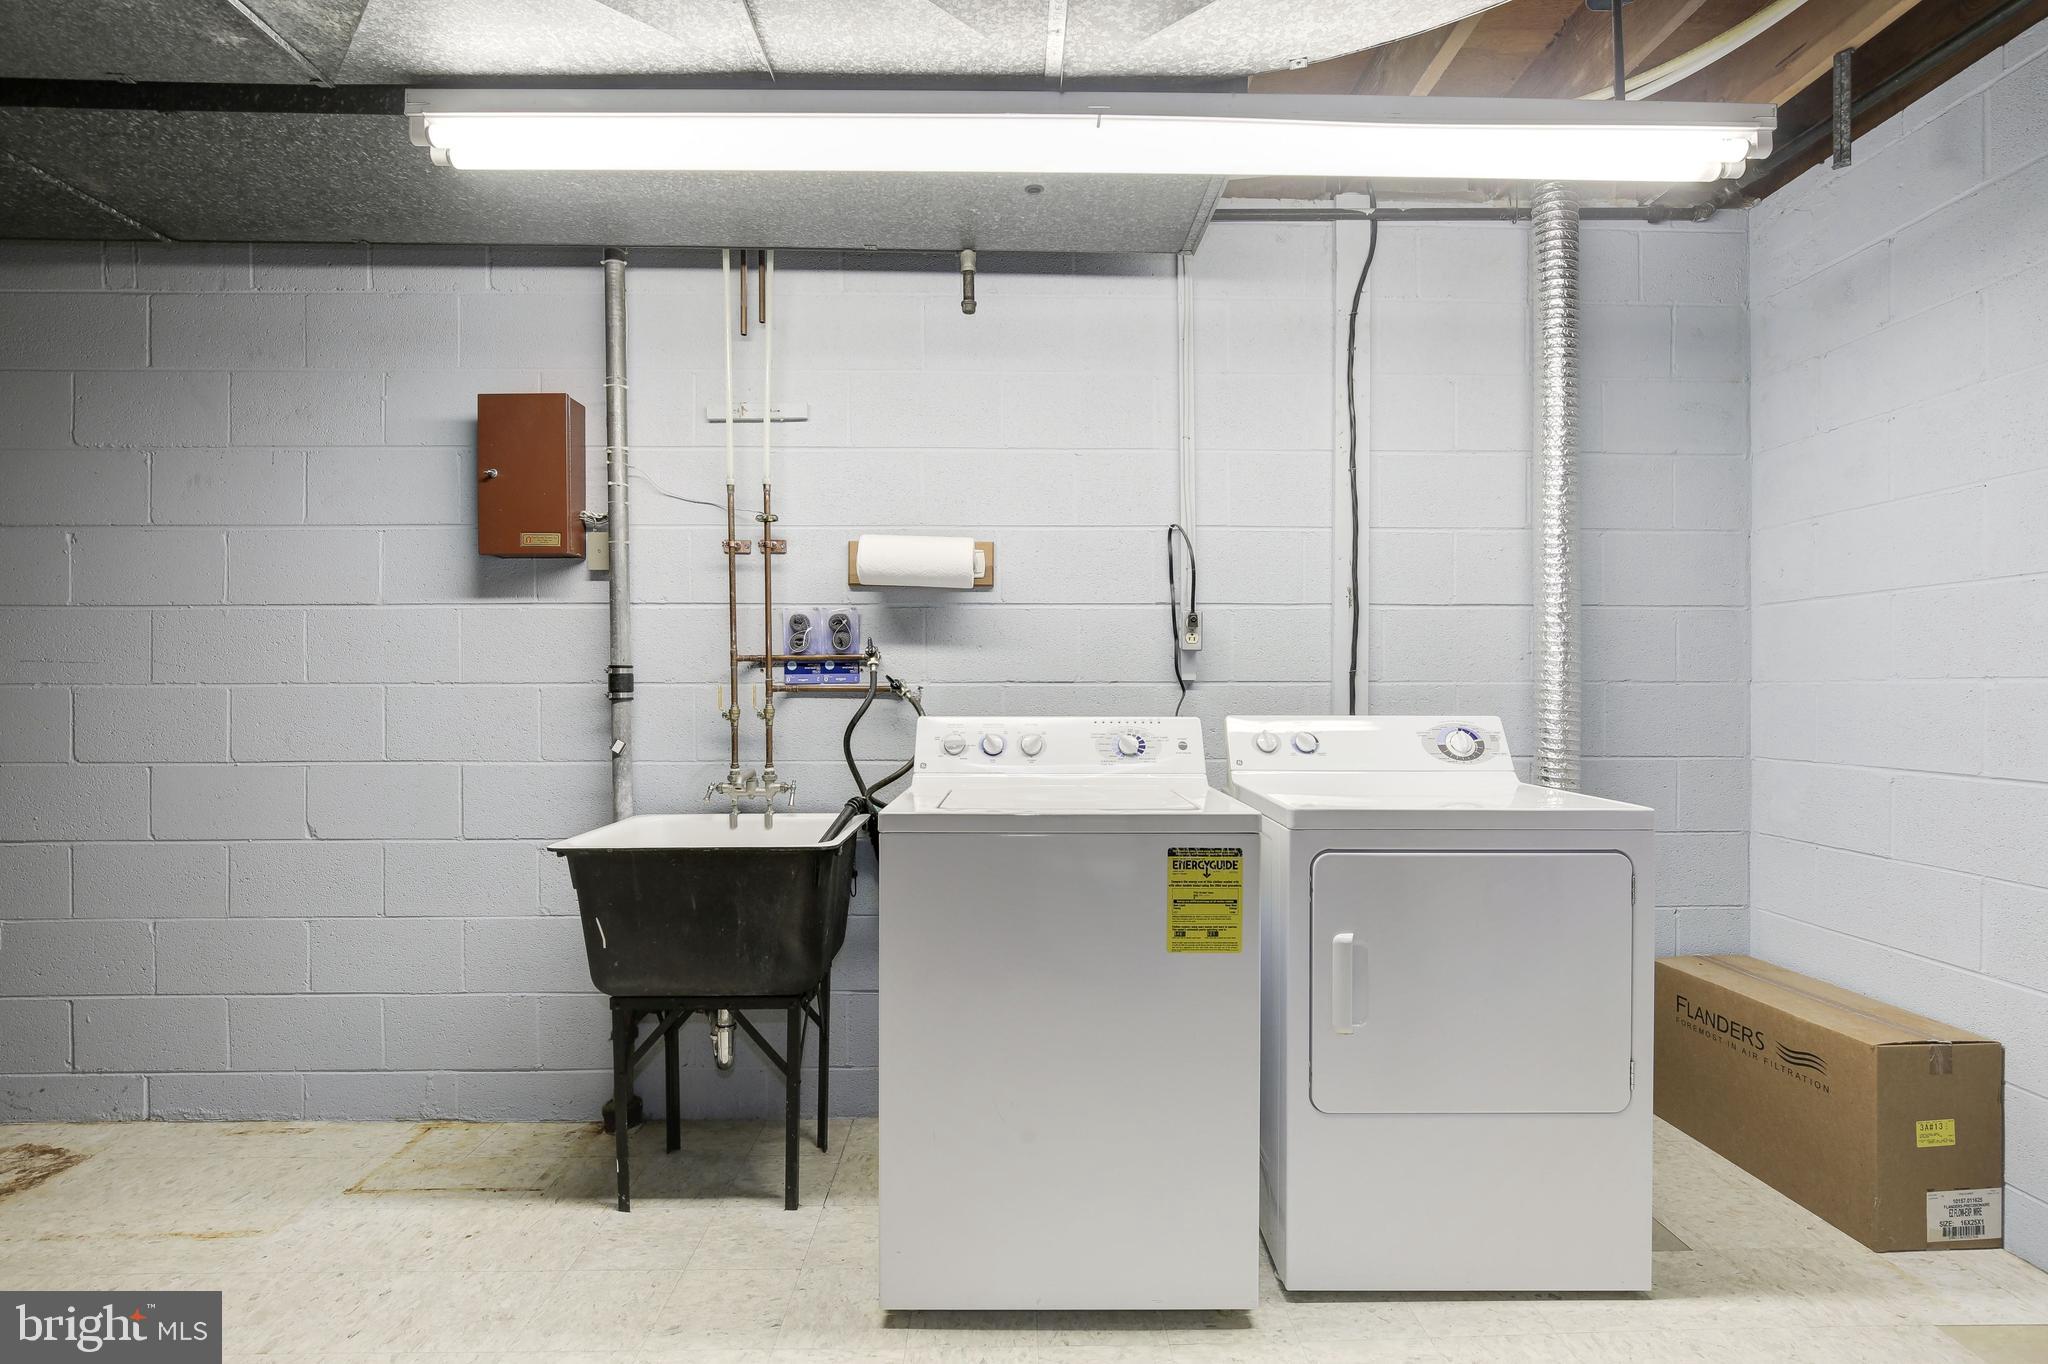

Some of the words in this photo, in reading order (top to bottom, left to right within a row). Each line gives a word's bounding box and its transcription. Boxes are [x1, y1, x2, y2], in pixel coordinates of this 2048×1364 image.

[1172, 860, 1239, 870] ENERGYGUIDE
[1676, 994, 1765, 1051] FLANDERS
[1675, 1016, 1723, 1044] FOREMOST
[1727, 1041, 1737, 1051] IN
[1741, 1047, 1758, 1061] AIR
[1763, 1057, 1830, 1094] FILTRATION
